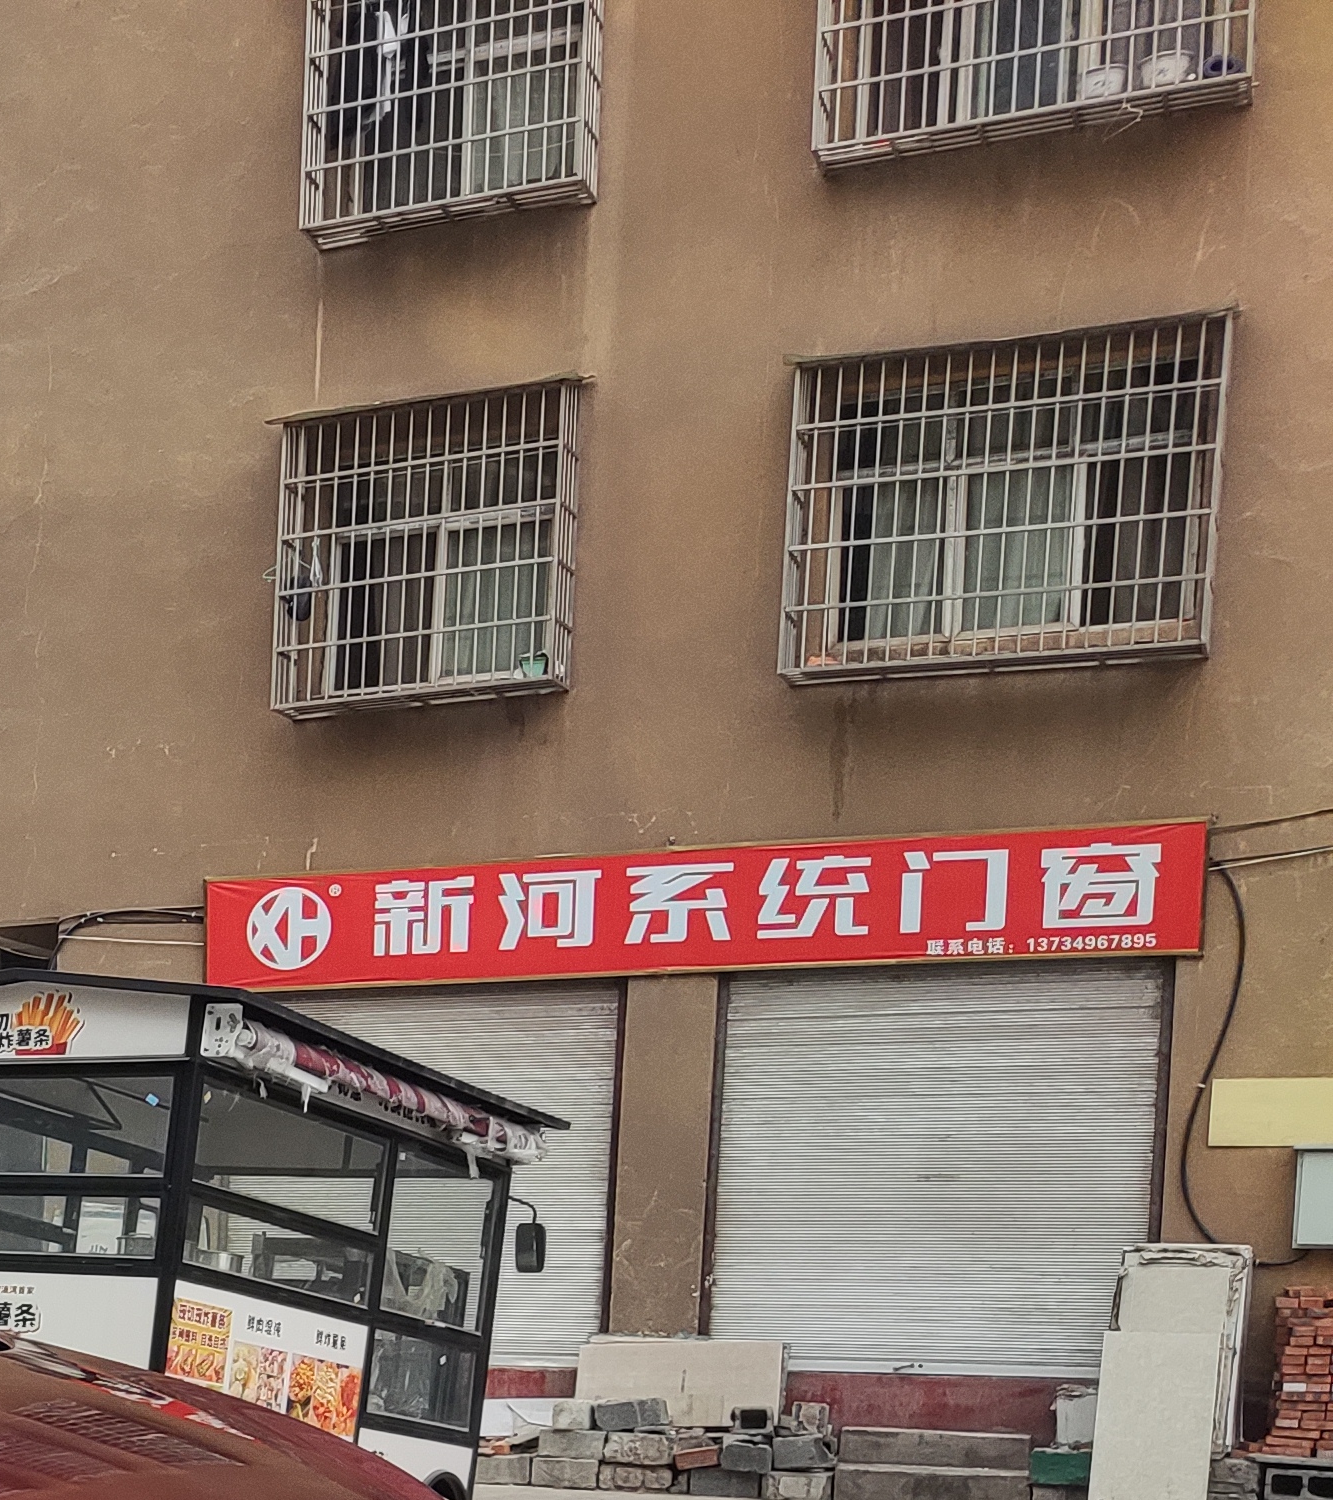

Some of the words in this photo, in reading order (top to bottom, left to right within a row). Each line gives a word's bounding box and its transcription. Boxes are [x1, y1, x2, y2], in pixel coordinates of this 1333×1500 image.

[373, 843, 1162, 957] 新河系统门窗
[1026, 932, 1157, 953] 13734967895
